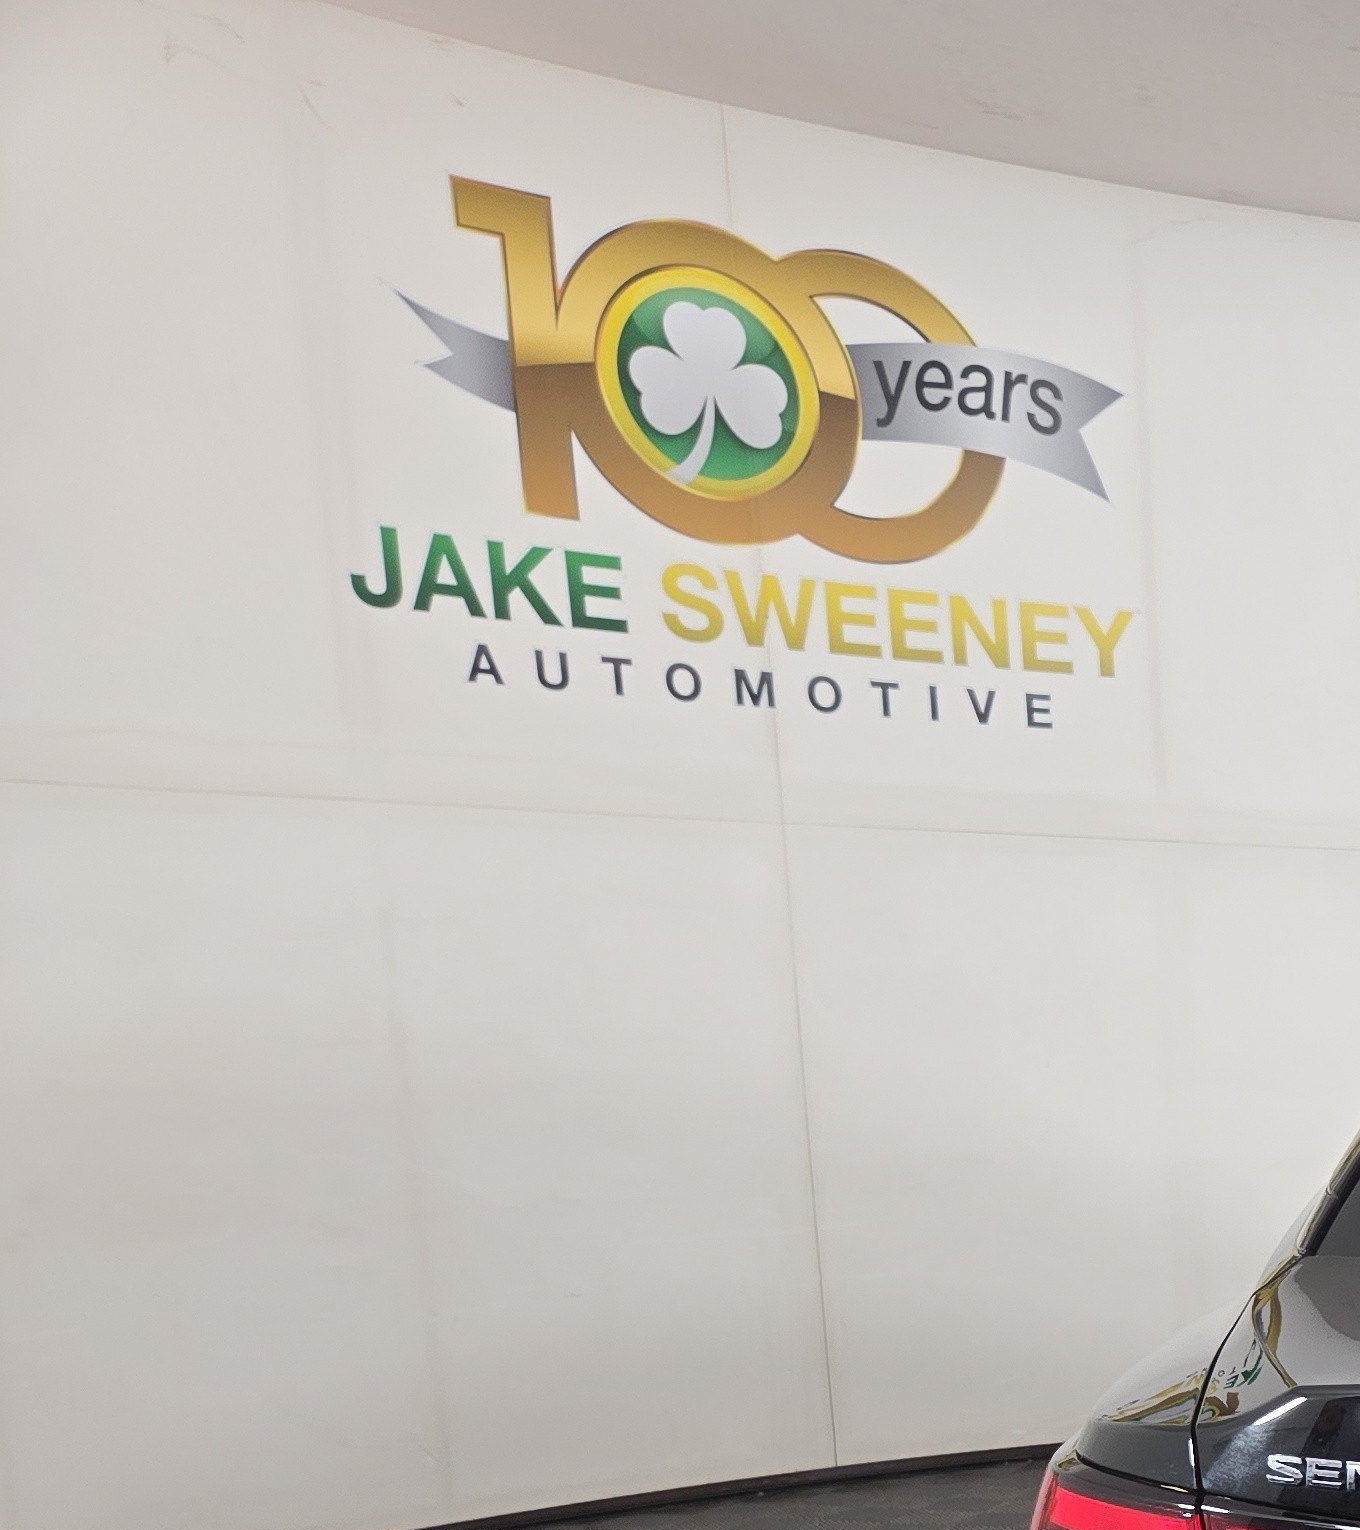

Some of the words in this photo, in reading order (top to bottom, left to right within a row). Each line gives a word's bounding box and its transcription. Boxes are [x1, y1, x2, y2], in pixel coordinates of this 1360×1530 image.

[872, 358, 1063, 435] years
[349, 525, 629, 633] JAKE
[661, 563, 1133, 678] SWEENEY
[468, 643, 1053, 729] AUTOMOTIVE
